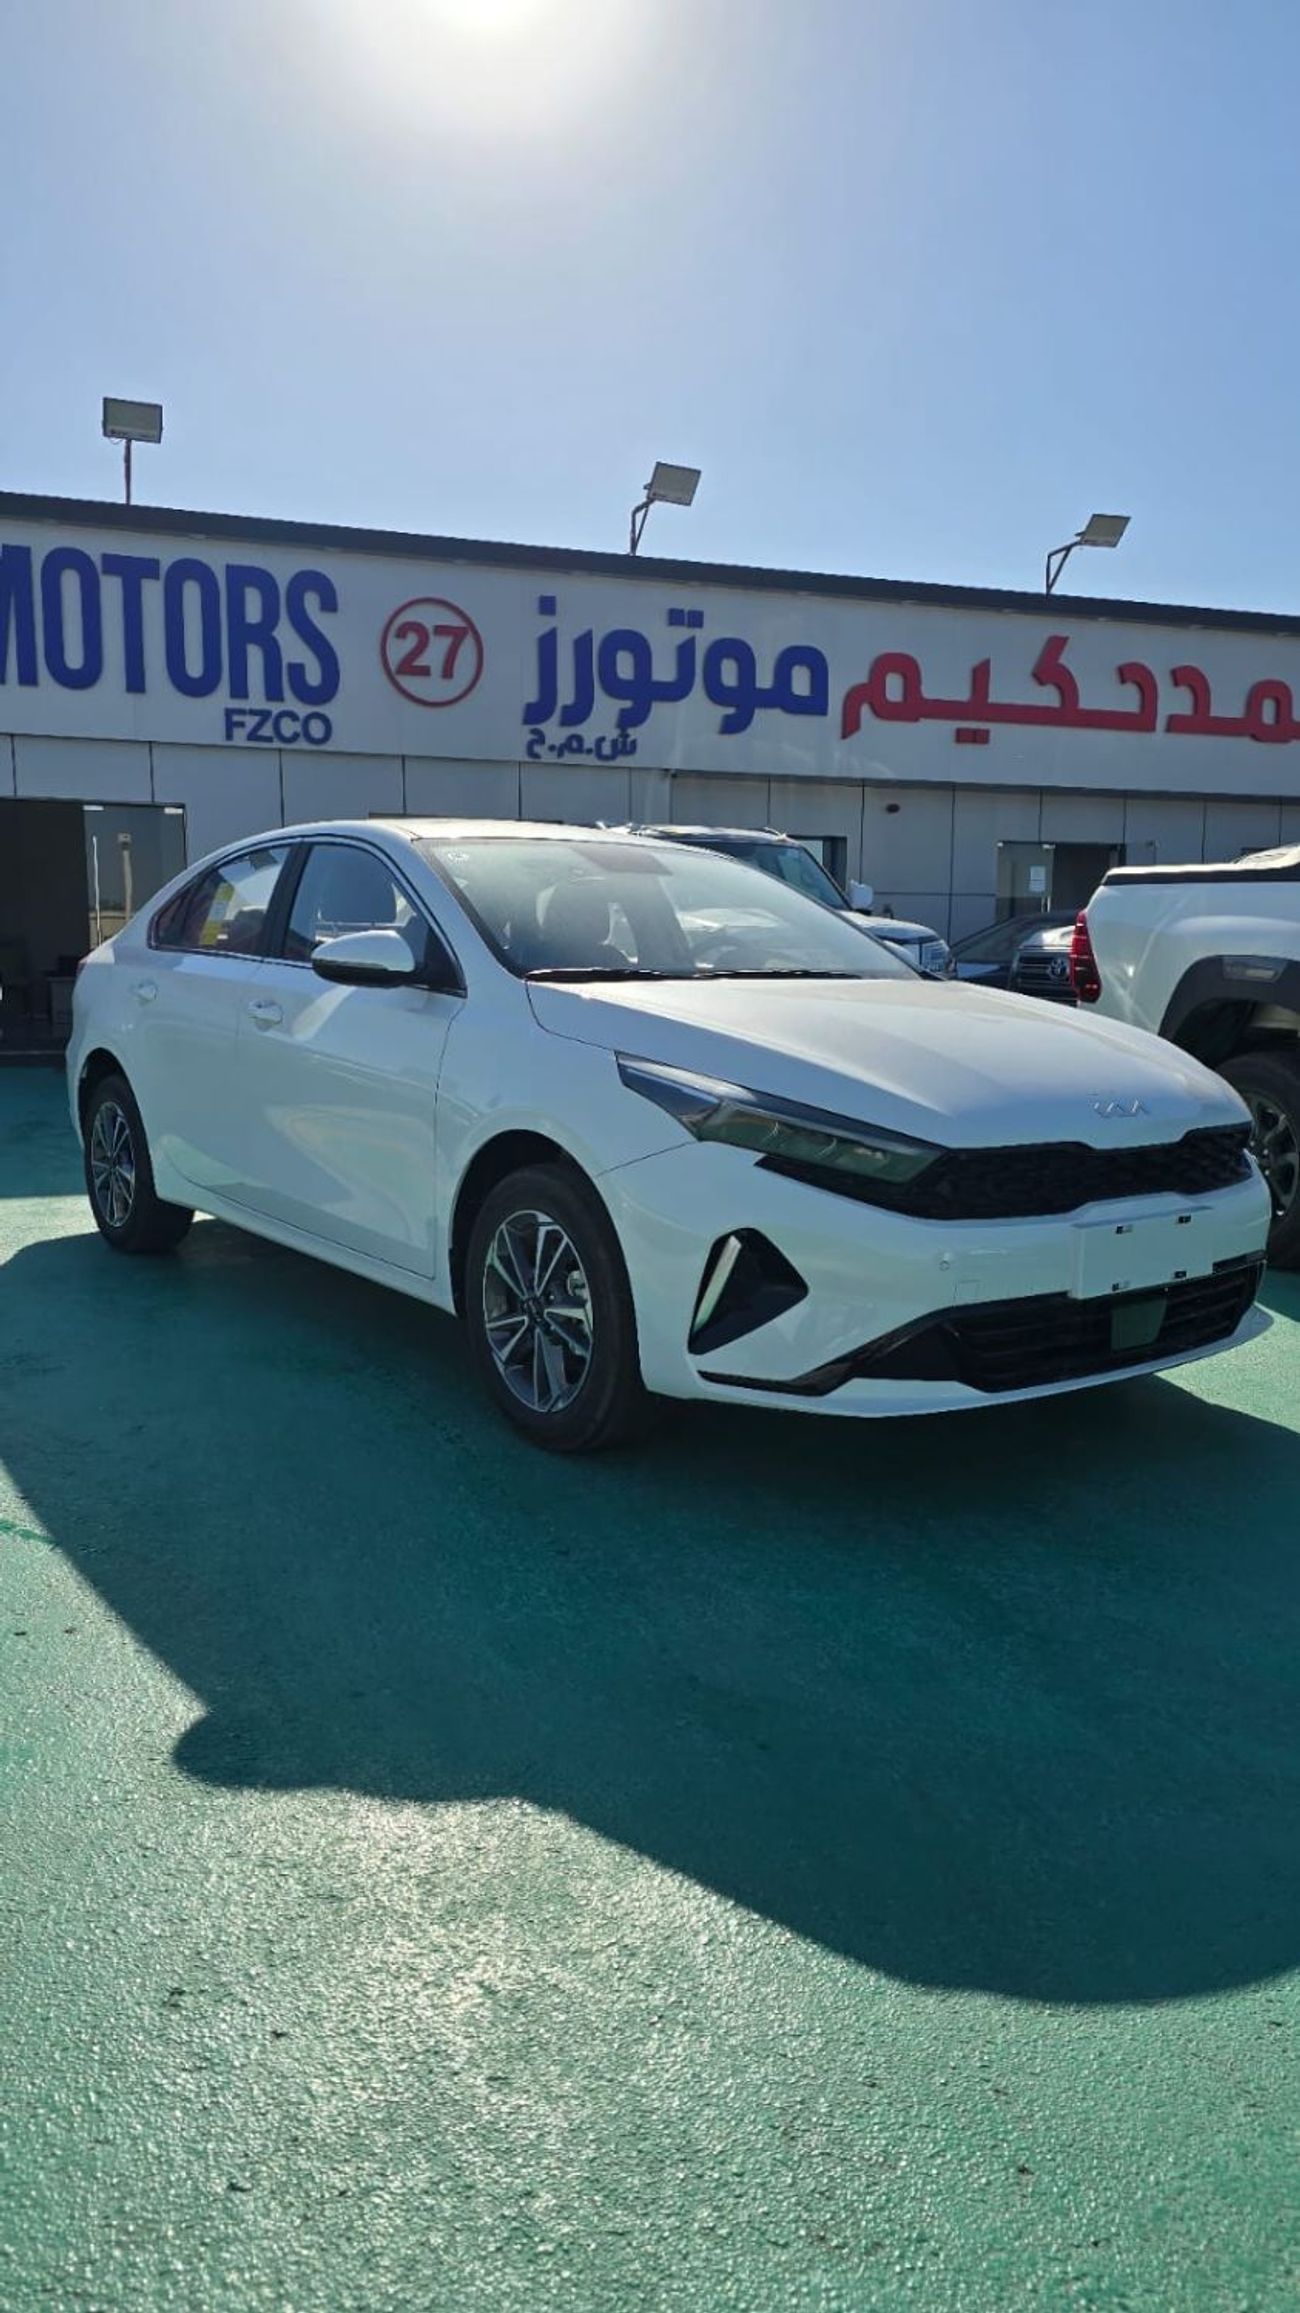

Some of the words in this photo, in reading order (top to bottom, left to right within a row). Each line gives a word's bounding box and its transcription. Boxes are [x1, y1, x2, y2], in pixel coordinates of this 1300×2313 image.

[395, 622, 469, 680] 27
[522, 595, 829, 735] موتورز
[225, 707, 332, 745] FZCO
[1165, 664, 1300, 743] مد
